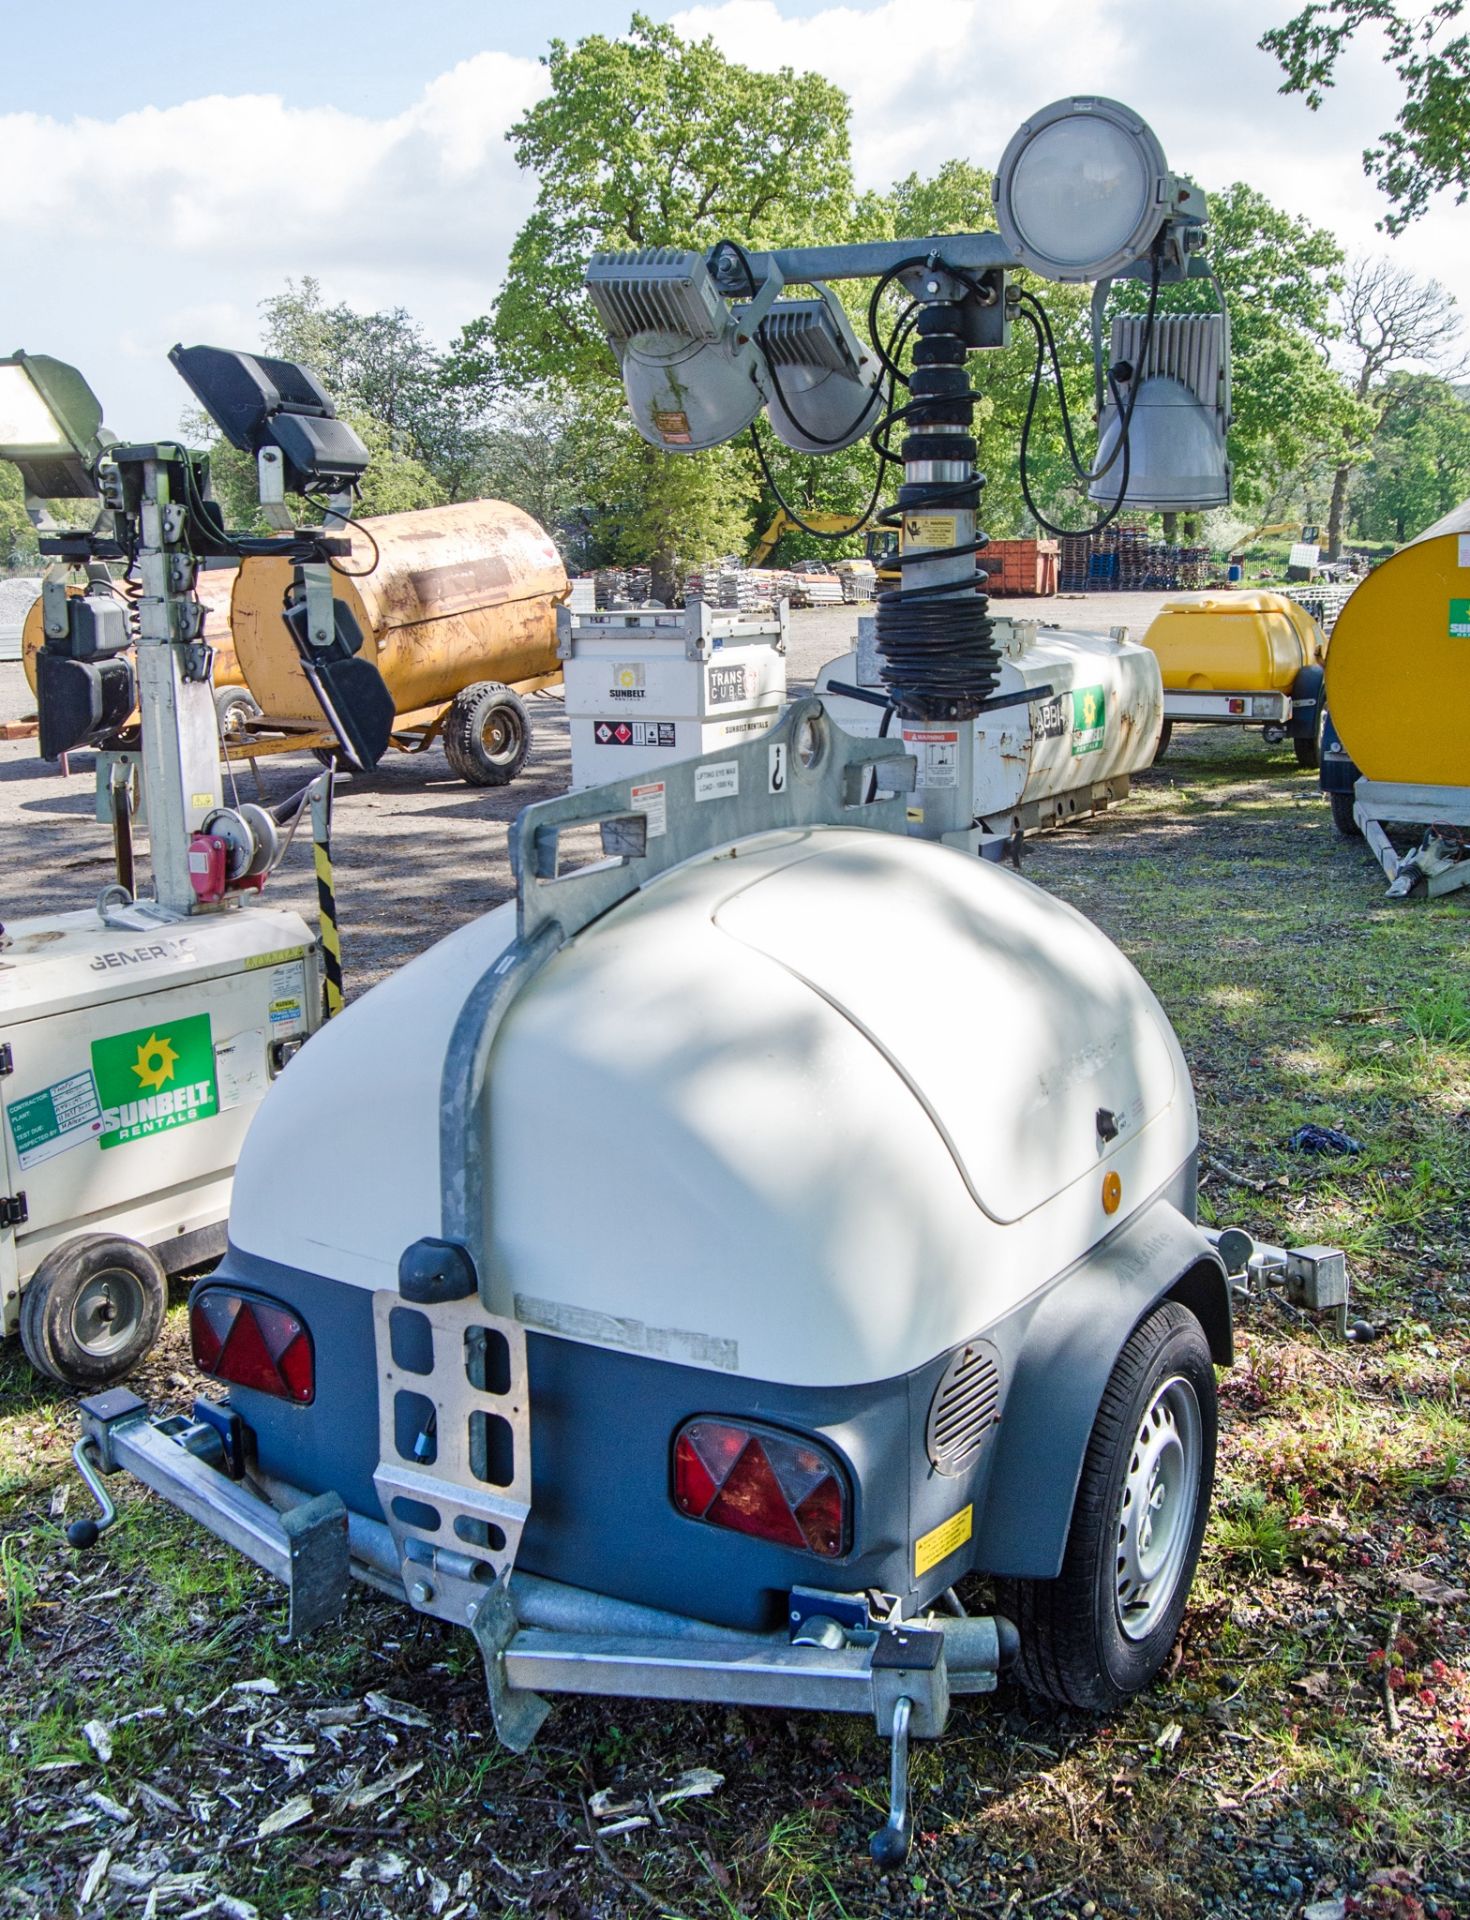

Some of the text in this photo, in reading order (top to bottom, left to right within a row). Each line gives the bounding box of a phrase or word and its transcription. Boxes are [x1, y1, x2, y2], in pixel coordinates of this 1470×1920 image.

[711, 670, 742, 686] TRANS
[609, 689, 646, 698] SUNBELT
[711, 684, 743, 699] CUBE
[102, 1080, 211, 1132] SUNBELT
[120, 1109, 198, 1140] RENTALS
[16, 1131, 30, 1141] TEST
